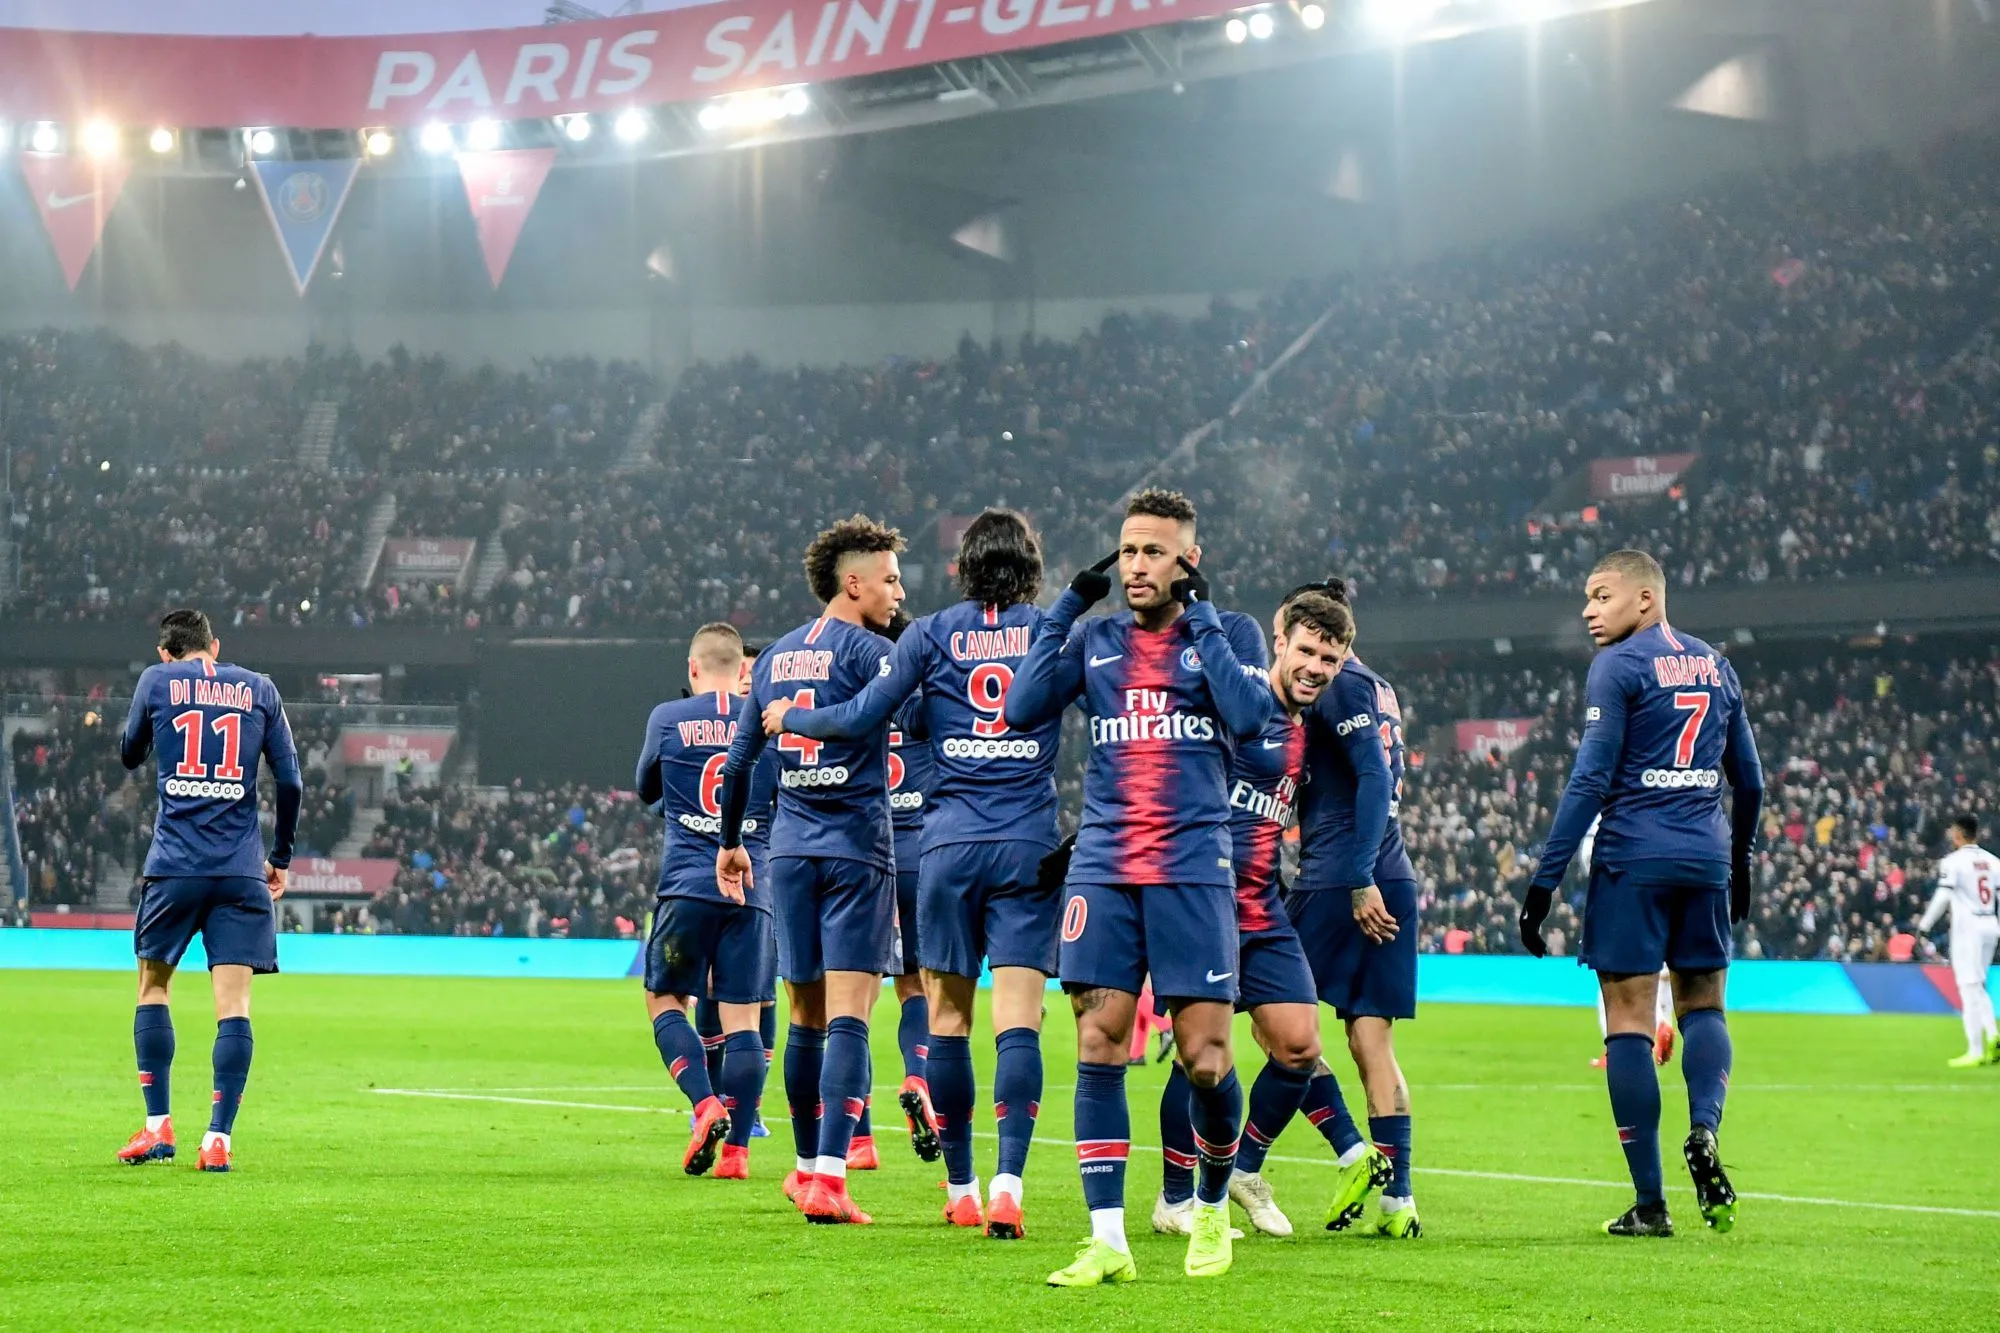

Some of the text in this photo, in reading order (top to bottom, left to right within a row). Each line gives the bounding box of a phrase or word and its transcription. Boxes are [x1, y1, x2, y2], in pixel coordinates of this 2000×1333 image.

[367, 30, 660, 110] PARIS
[950, 626, 1029, 661] CAVANI
[771, 650, 833, 683] KEHRER
[170, 679, 252, 712] DI MARÍA
[967, 662, 1015, 738] 9
[1125, 688, 1168, 714] Fly
[678, 720, 738, 747] VERRA
[778, 689, 824, 765] 4
[1090, 710, 1215, 747] Emirates
[1336, 713, 1371, 736] QNB
[1674, 692, 1710, 768] 7
[172, 710, 244, 780] 11
[944, 738, 1040, 758] ooredoo
[166, 779, 244, 799] ooredoo
[781, 766, 848, 788] redoo
[1276, 775, 1297, 802] Fly
[311, 858, 336, 873] Fly
[286, 872, 363, 892] Emirates
[1978, 874, 1991, 905] 6
[1081, 1165, 1114, 1175] PARIS
